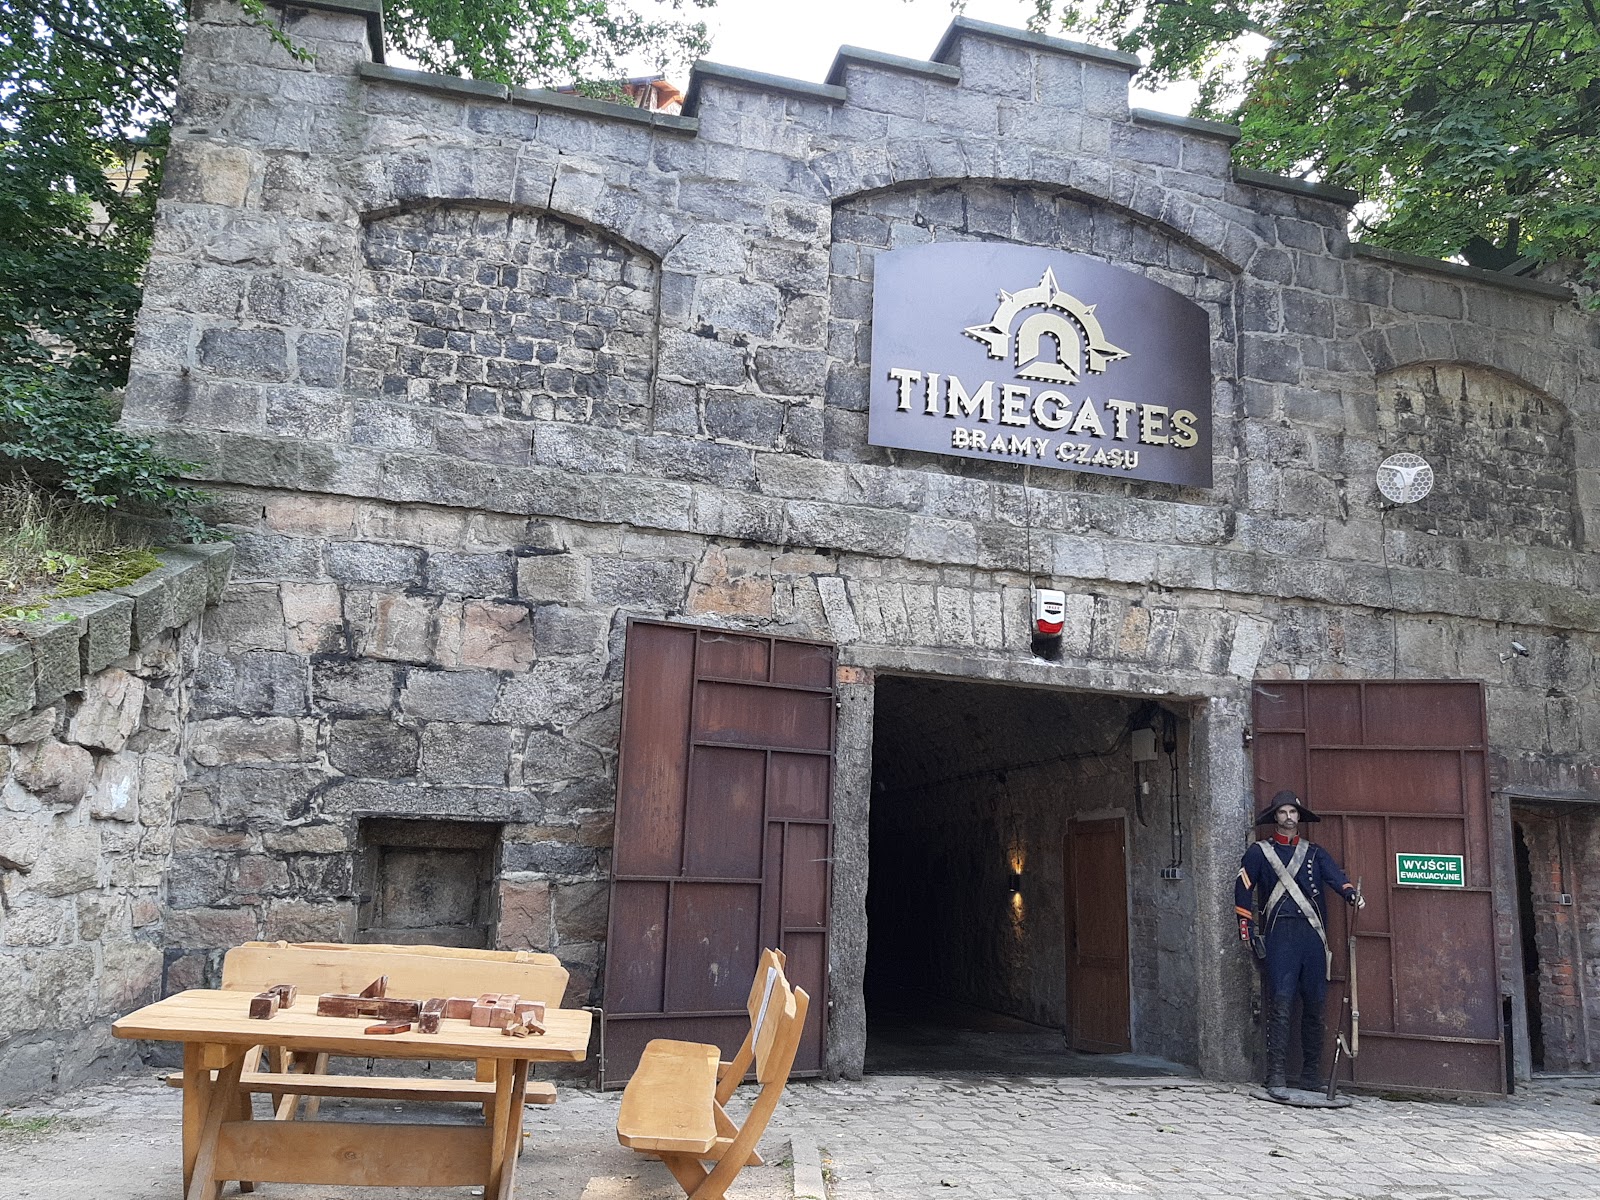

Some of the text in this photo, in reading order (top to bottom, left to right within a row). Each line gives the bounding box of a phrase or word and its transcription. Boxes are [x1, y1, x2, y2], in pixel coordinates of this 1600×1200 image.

[889, 367, 1199, 449] TIMEGATES
[954, 426, 1140, 470] BRAMY CZASU
[1400, 871, 1460, 880] EWAKUACYJNE
[1403, 859, 1457, 871] WYJŚCIE
